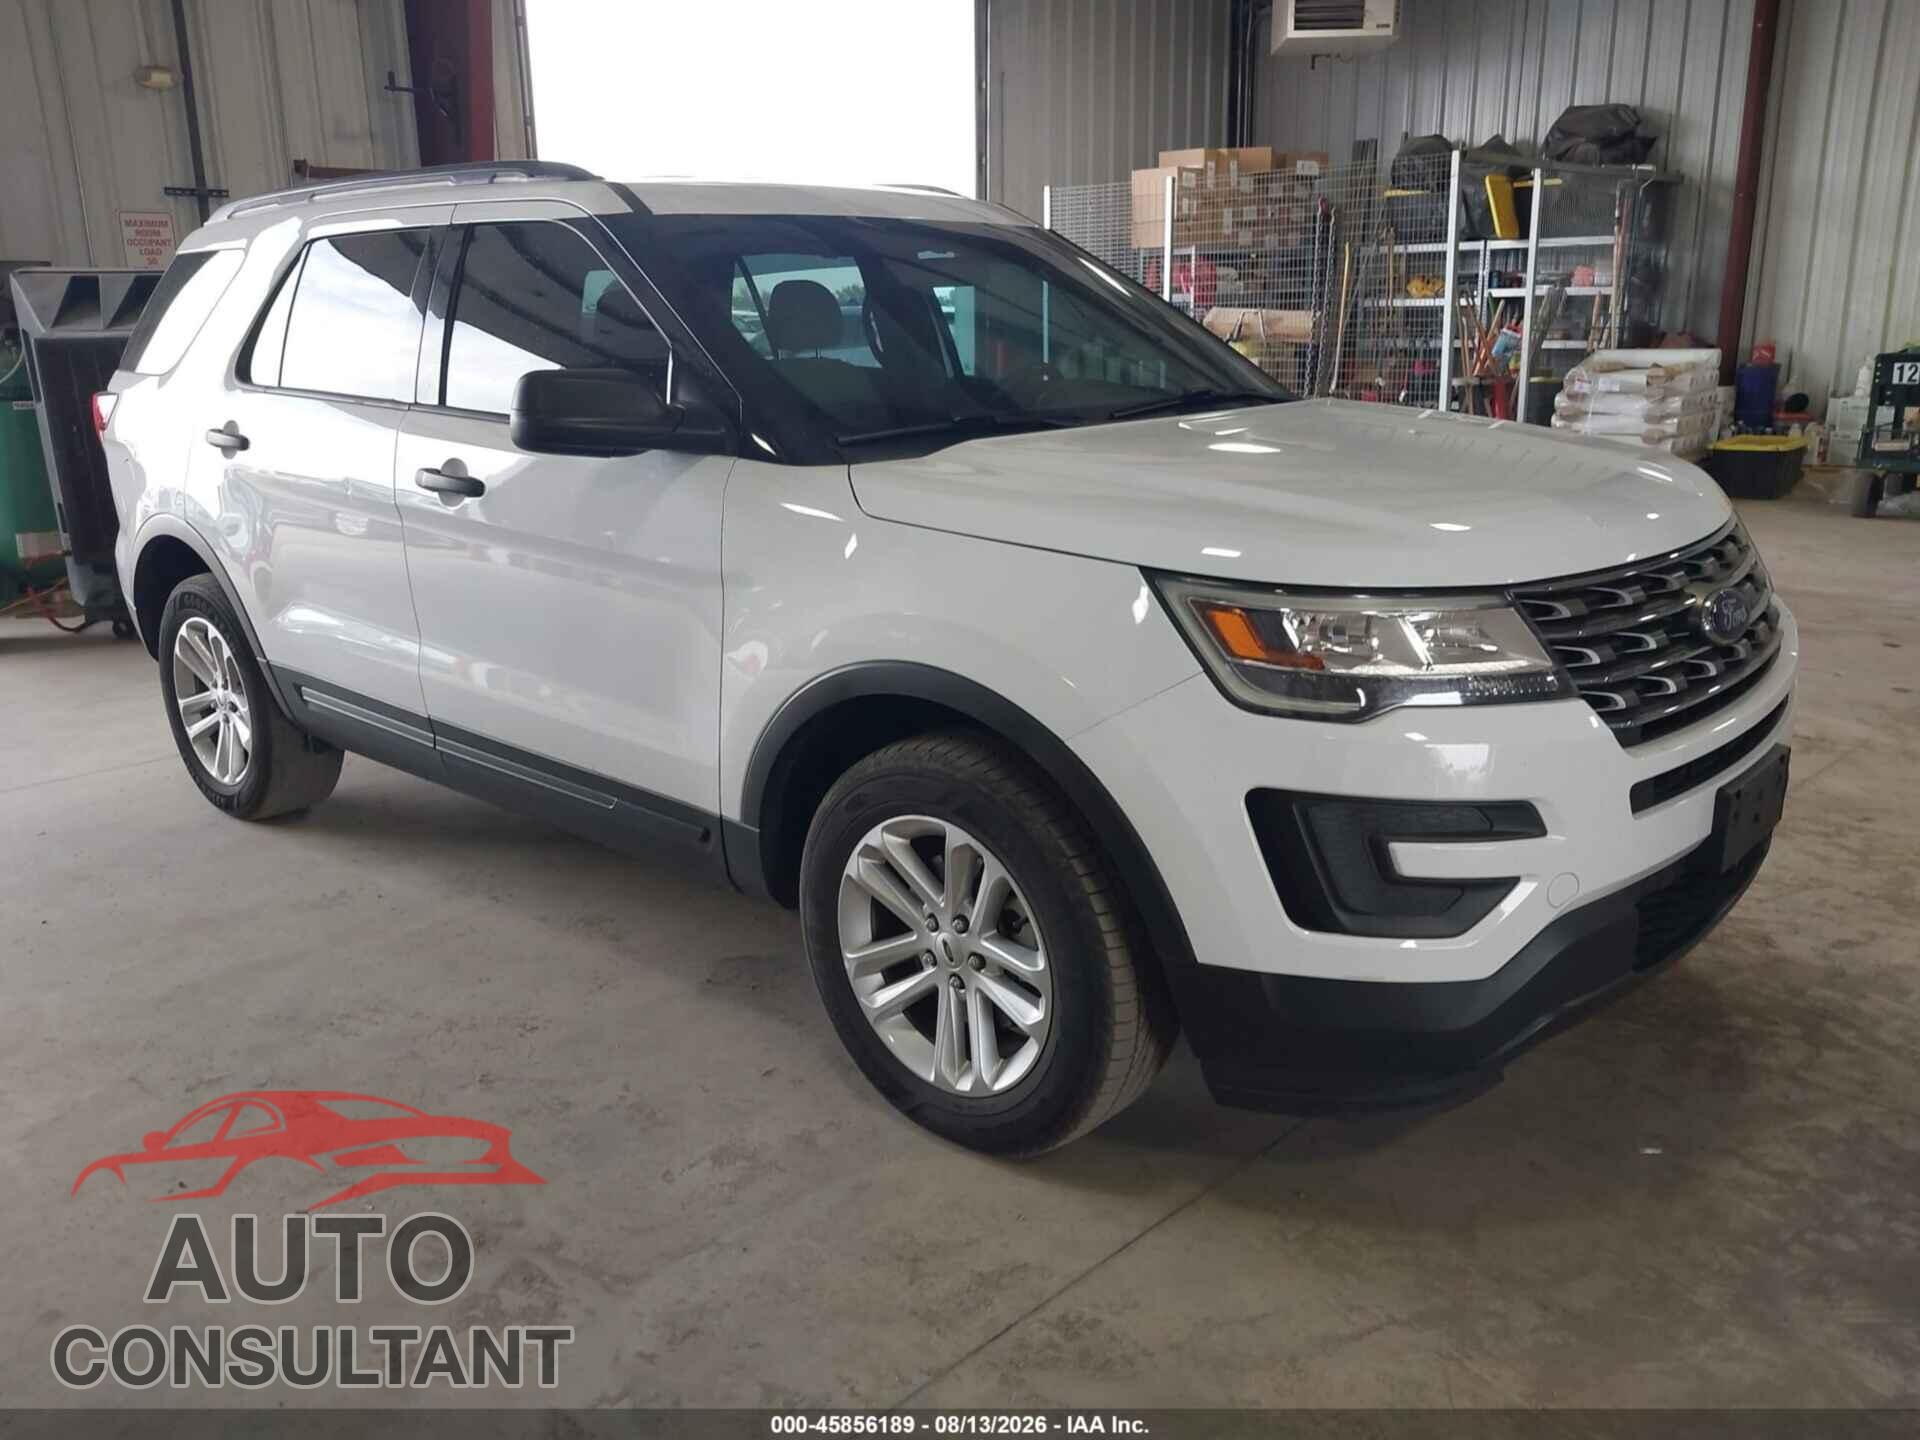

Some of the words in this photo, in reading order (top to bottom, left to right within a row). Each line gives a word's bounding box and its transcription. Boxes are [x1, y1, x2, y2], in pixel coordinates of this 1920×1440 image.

[124, 219, 169, 228] MAXIMUM
[135, 229, 161, 237] ROOM
[127, 239, 172, 248] OCCUPANT
[140, 248, 163, 256] LOAD
[1720, 597, 1747, 632] Ford
